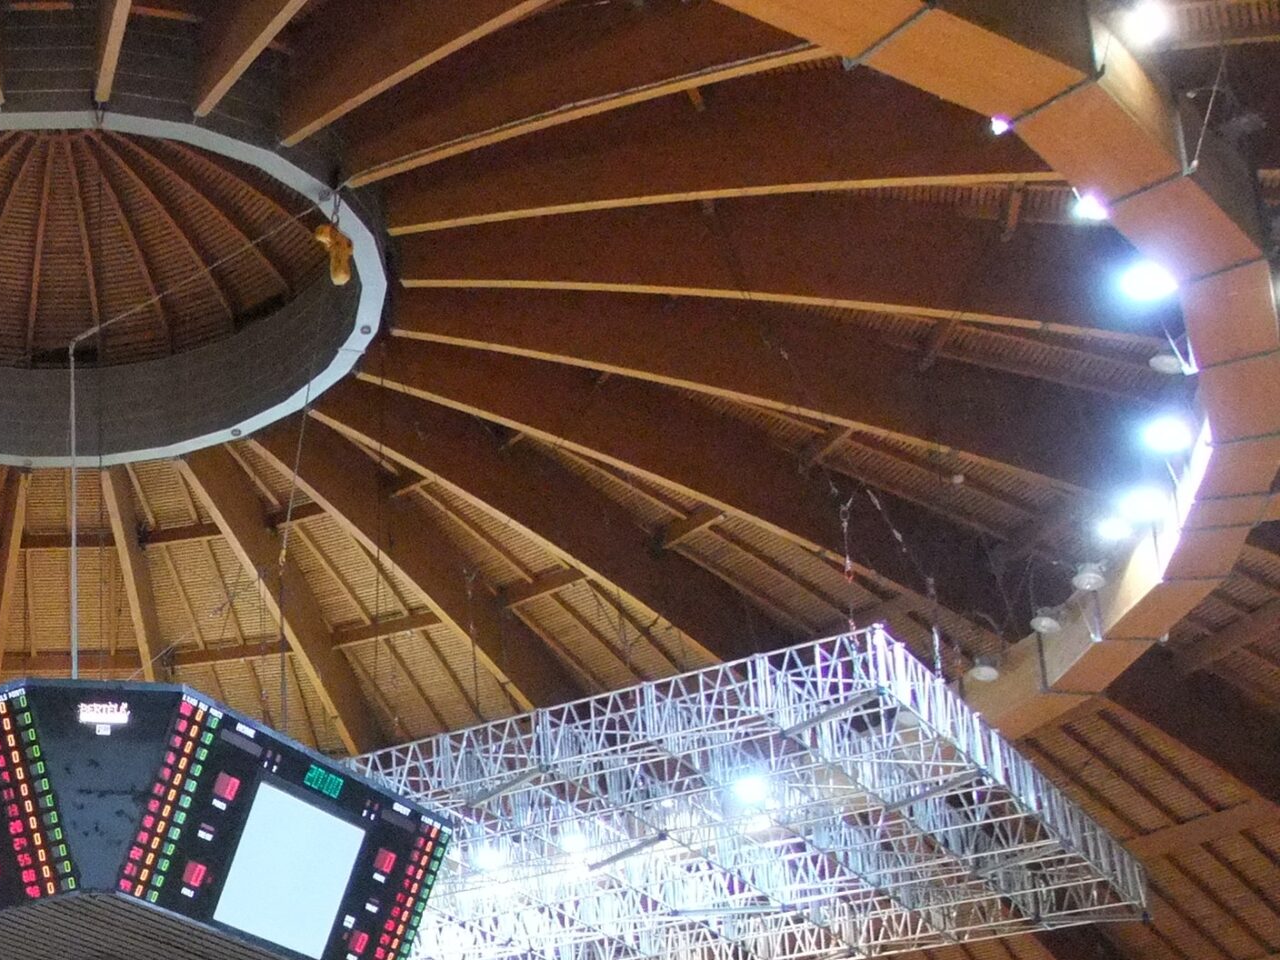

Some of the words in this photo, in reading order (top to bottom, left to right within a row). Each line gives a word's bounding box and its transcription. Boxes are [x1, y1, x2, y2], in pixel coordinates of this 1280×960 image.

[0, 702, 6, 714] 0
[20, 696, 26, 707] 0
[3, 718, 11, 730] 0
[24, 712, 31, 724] 0
[8, 734, 15, 746] 0
[29, 729, 35, 740] 0
[12, 751, 19, 763] 0
[33, 745, 40, 756] 0
[16, 767, 24, 779] 0
[37, 762, 44, 773] 0
[21, 784, 28, 796] 0
[42, 778, 49, 790] 0
[303, 764, 344, 799] 20:00
[25, 800, 32, 812] 0
[46, 795, 53, 806] 0
[30, 816, 37, 828] 0
[51, 811, 57, 822] 0
[34, 833, 41, 845] 0
[55, 828, 62, 839] 0
[38, 849, 45, 861] 0
[59, 844, 66, 856] 0
[43, 866, 50, 878] 0
[64, 861, 71, 872] 0
[47, 882, 54, 894] 0
[68, 877, 75, 888] 0
